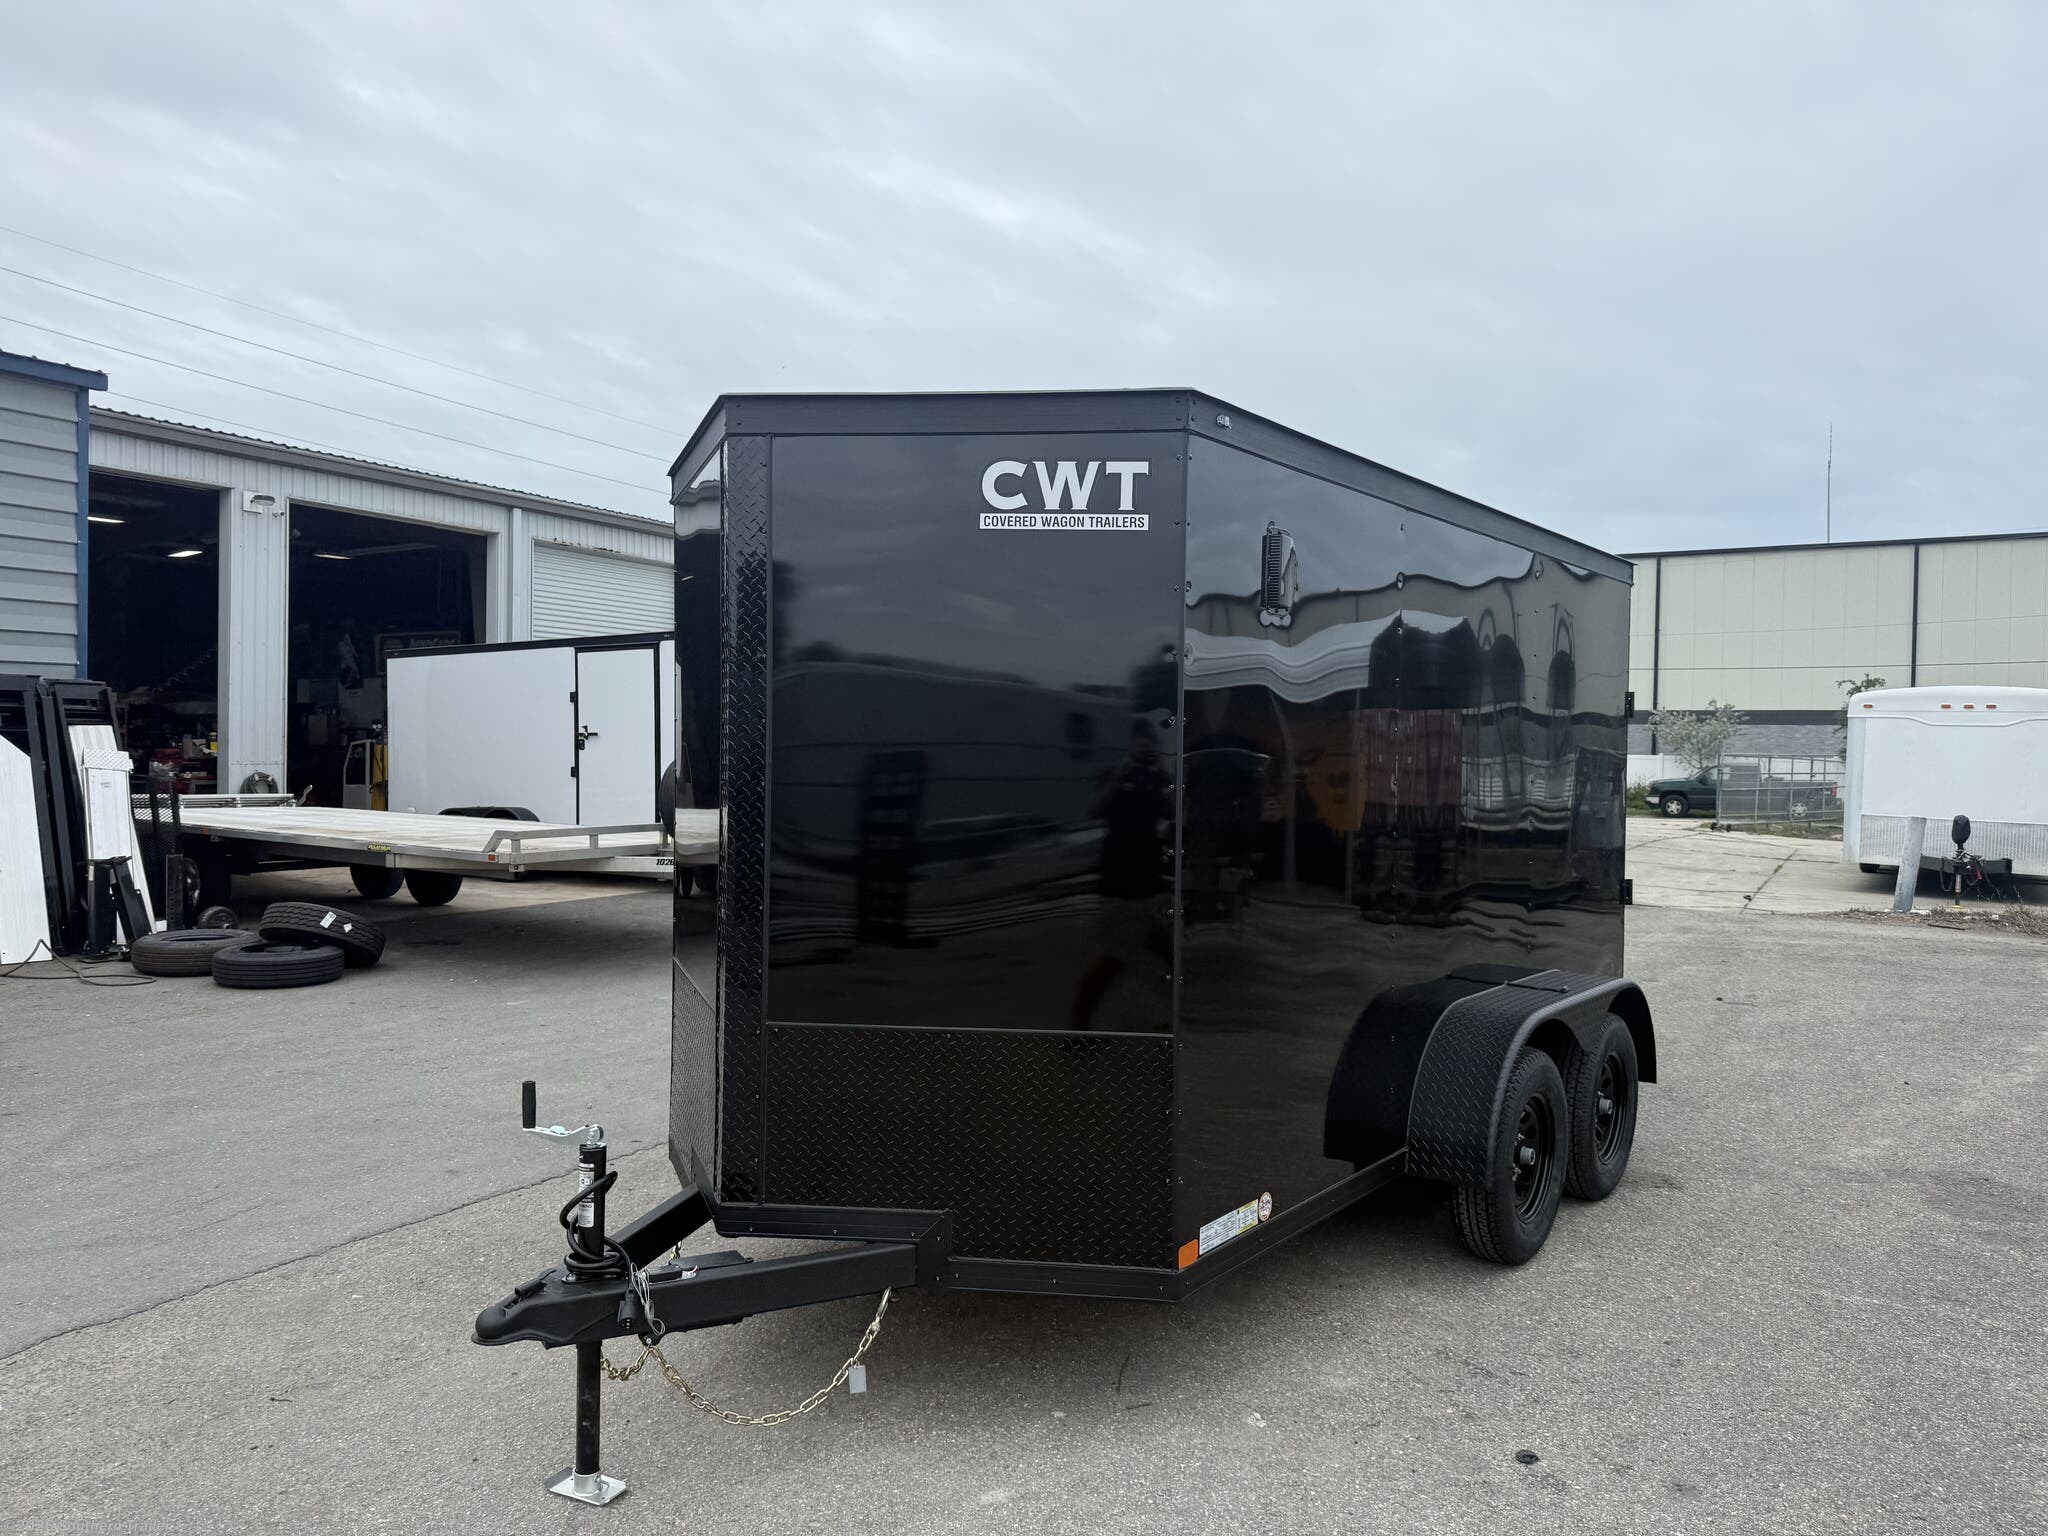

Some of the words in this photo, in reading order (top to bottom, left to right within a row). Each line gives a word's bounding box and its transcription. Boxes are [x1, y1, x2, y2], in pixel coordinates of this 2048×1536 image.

[982, 460, 1149, 510] CWT
[983, 515, 1037, 527] COVERED
[1041, 515, 1085, 528] WAGON
[1089, 516, 1145, 528] TRAILERS
